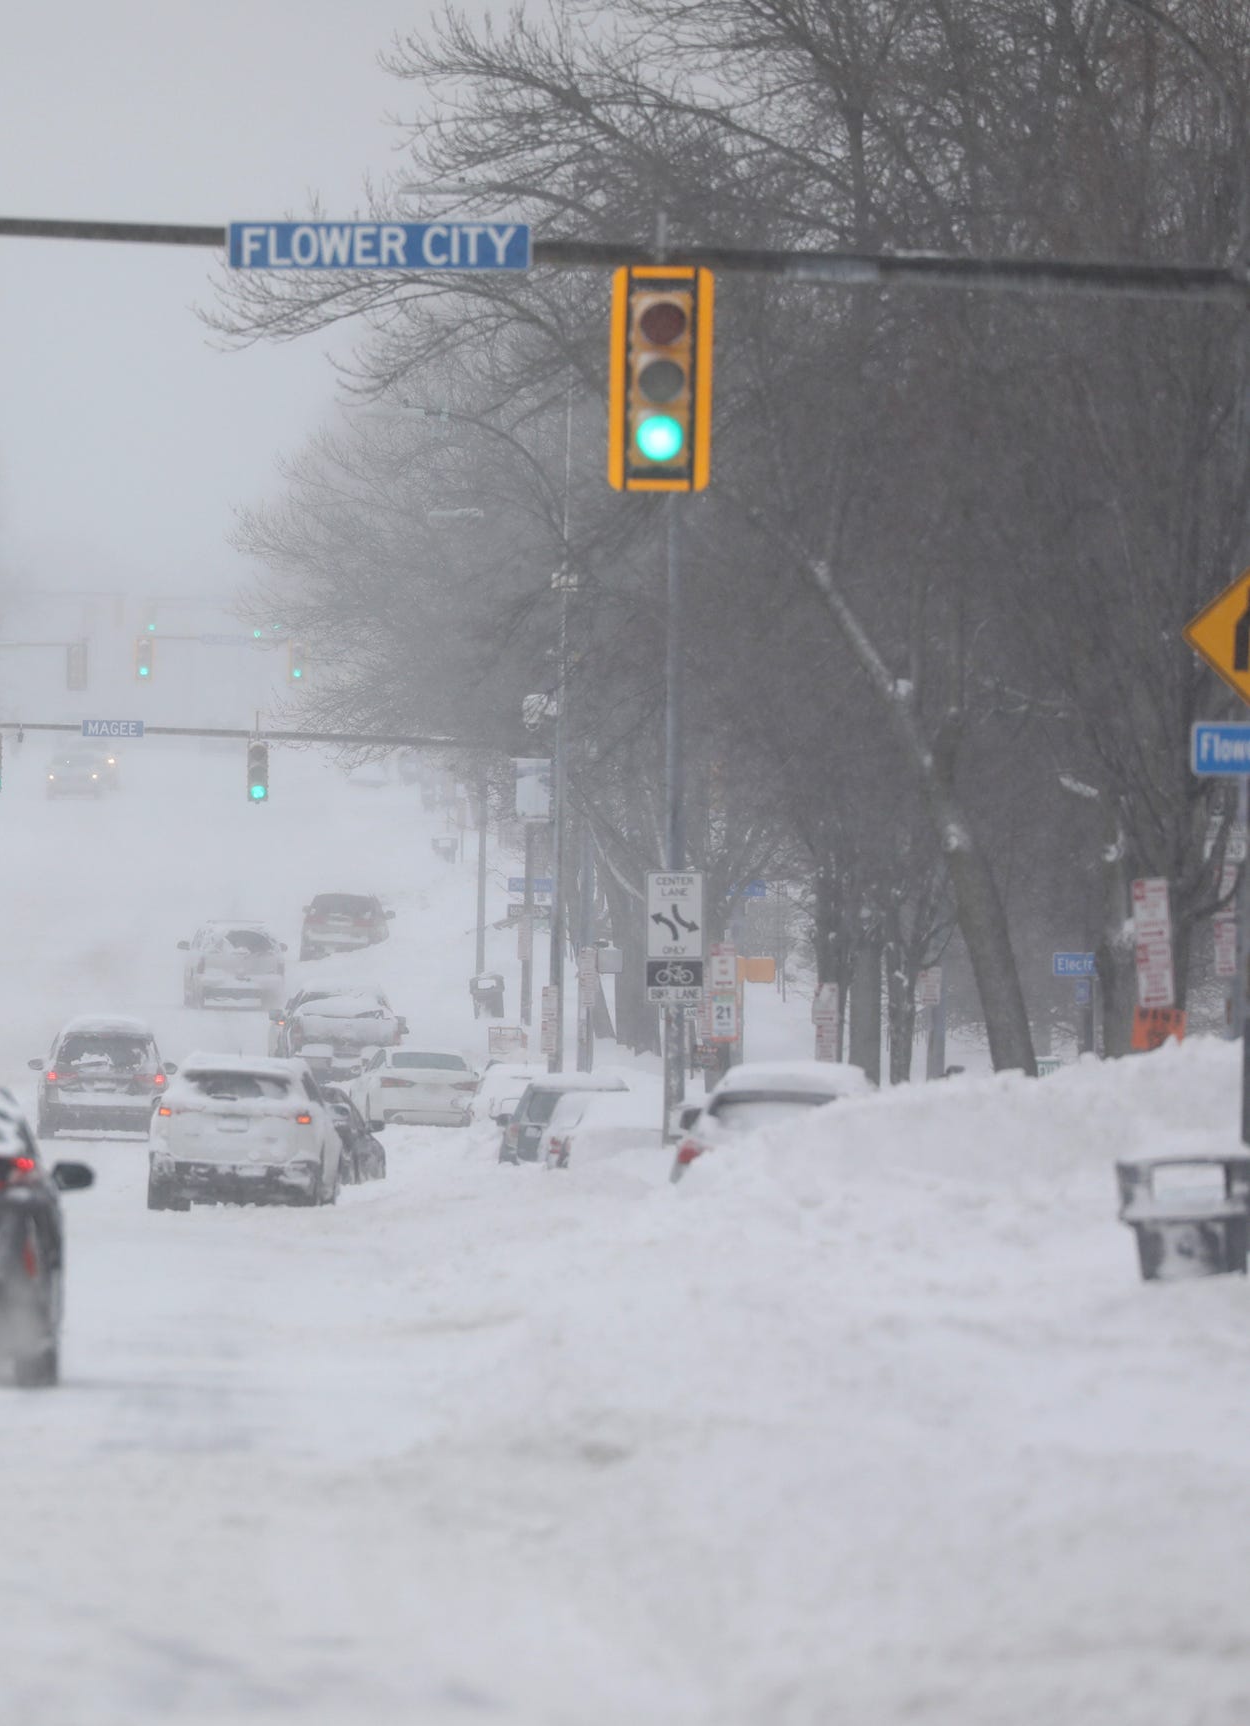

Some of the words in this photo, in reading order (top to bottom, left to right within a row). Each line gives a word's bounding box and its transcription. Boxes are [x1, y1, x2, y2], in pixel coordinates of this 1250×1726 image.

[241, 226, 407, 265] FLOWER
[422, 225, 518, 265] CITY
[87, 721, 137, 736] MAGEE
[655, 876, 694, 886] CENTER
[661, 887, 689, 897] LANE
[662, 946, 687, 955] ONLY
[675, 988, 700, 1000] LANE
[716, 1005, 731, 1019] 21
